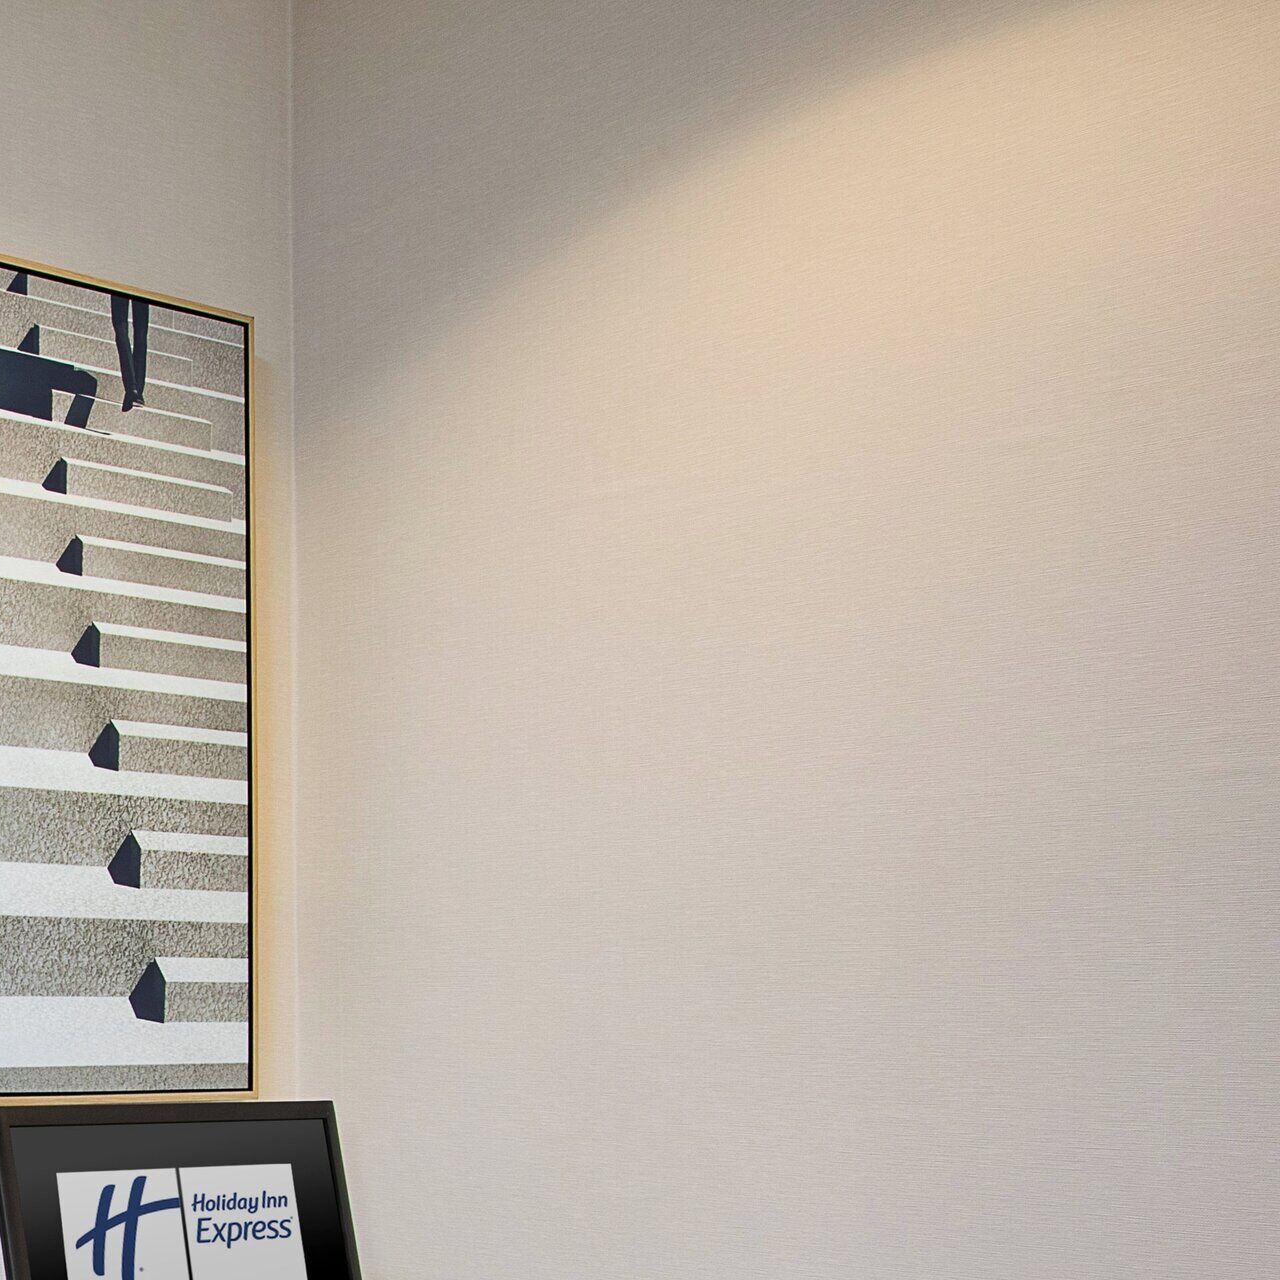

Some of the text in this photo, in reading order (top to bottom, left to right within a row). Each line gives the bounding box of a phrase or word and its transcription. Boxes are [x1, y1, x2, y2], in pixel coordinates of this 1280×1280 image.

[190, 1190, 289, 1214] Holiday Inn
[194, 1217, 293, 1249] Express
